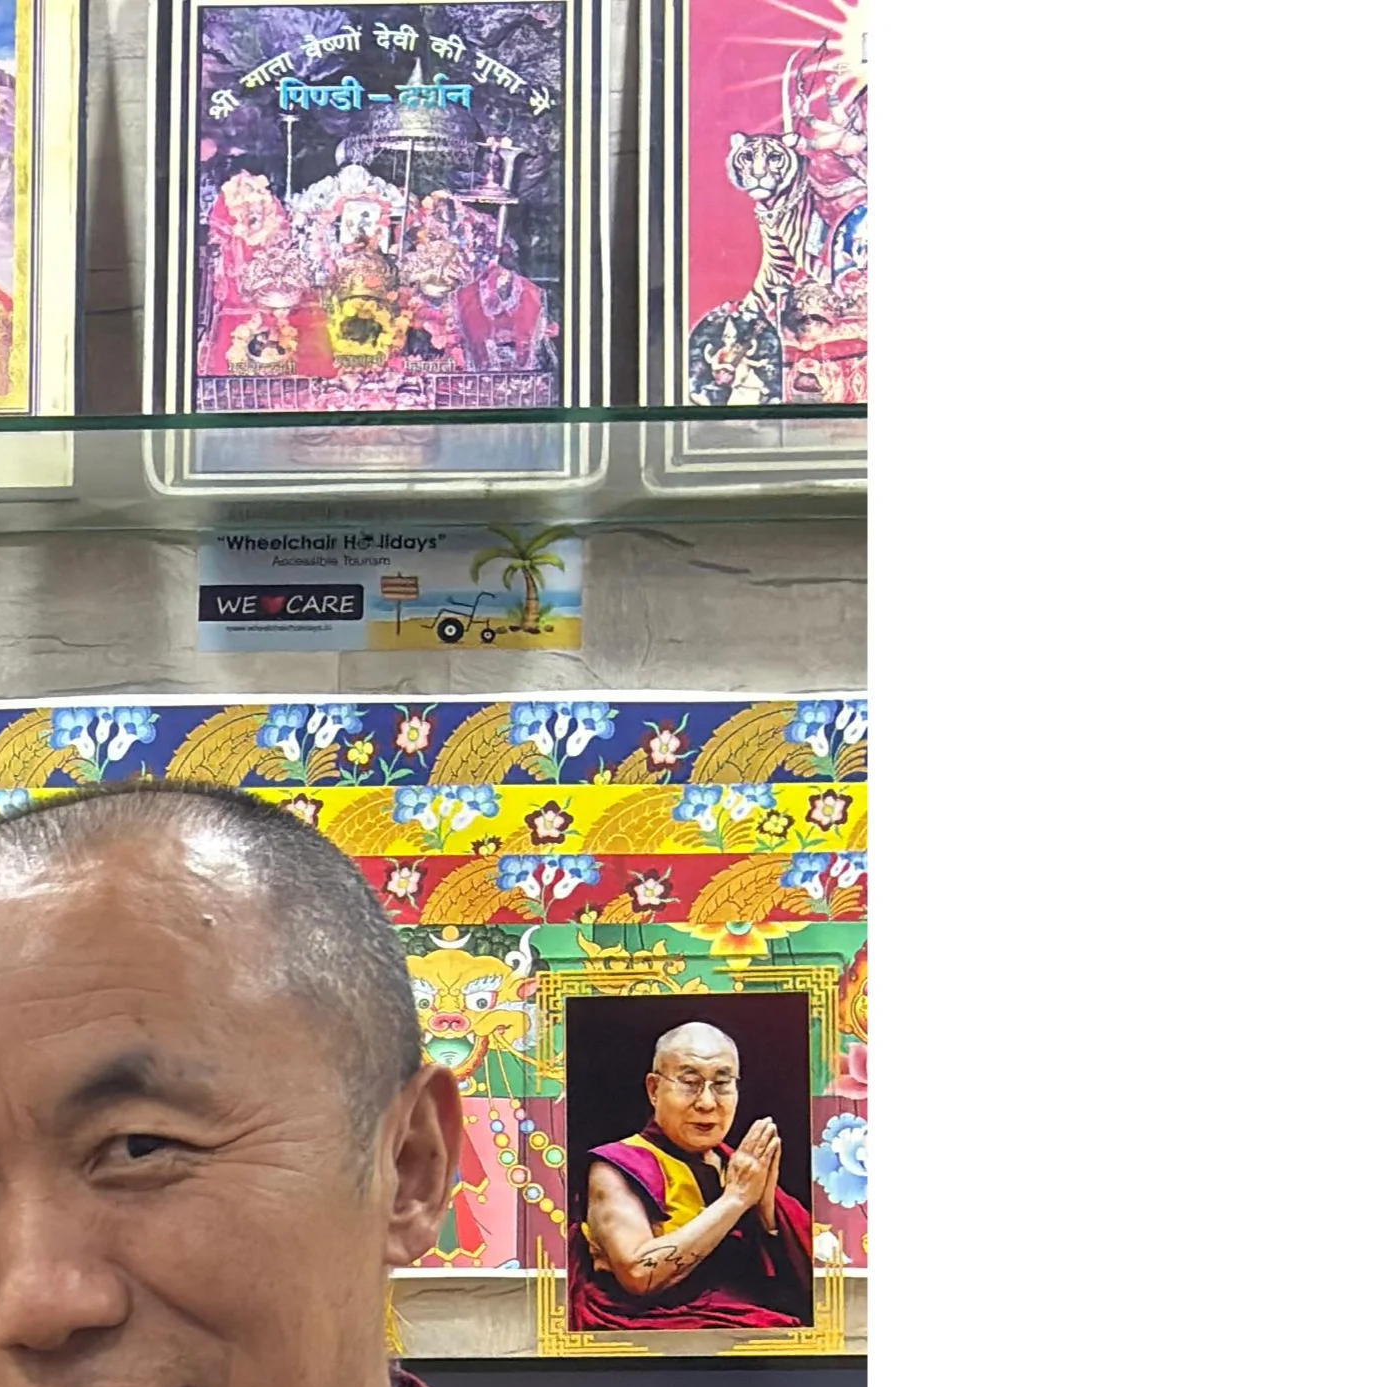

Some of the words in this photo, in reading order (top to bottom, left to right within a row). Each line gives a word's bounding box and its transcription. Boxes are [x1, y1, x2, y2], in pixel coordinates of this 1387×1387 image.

[209, 89, 240, 120] श्री
[239, 52, 294, 90] माता
[373, 22, 419, 51] देवी
[430, 35, 466, 64] की
[472, 52, 526, 95] गुफा
[279, 76, 364, 111] पिण्डी
[396, 73, 472, 110] दर्शन
[272, 555, 338, 567] Accessible
[343, 554, 391, 566] Tourism
[217, 596, 257, 615] WE
[286, 594, 356, 614] CARE
